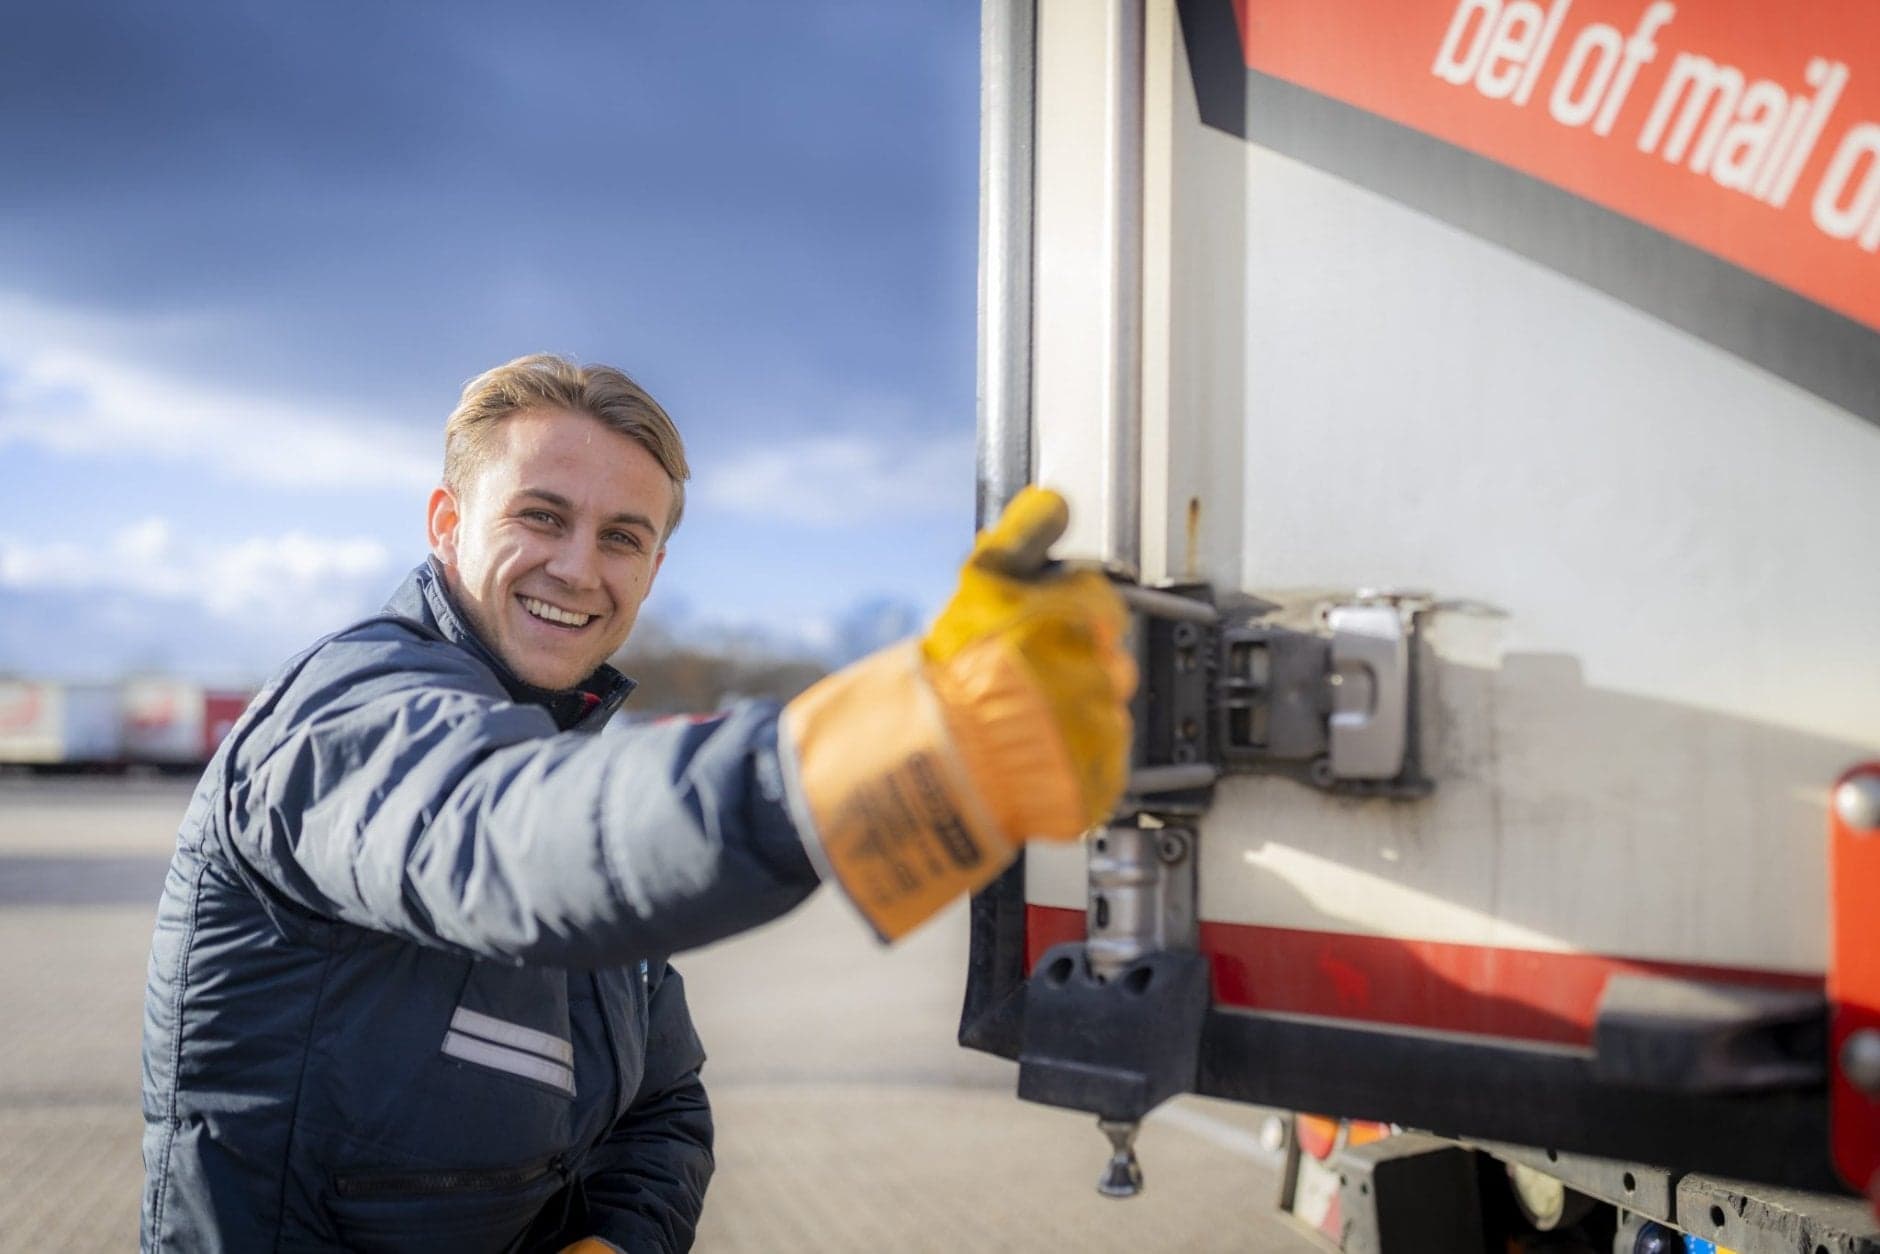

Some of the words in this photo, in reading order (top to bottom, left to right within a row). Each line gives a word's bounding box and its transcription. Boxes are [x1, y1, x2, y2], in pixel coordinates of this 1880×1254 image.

[1549, 1, 1676, 137] of
[1637, 52, 1849, 209] mail
[1811, 122, 1880, 254] o
